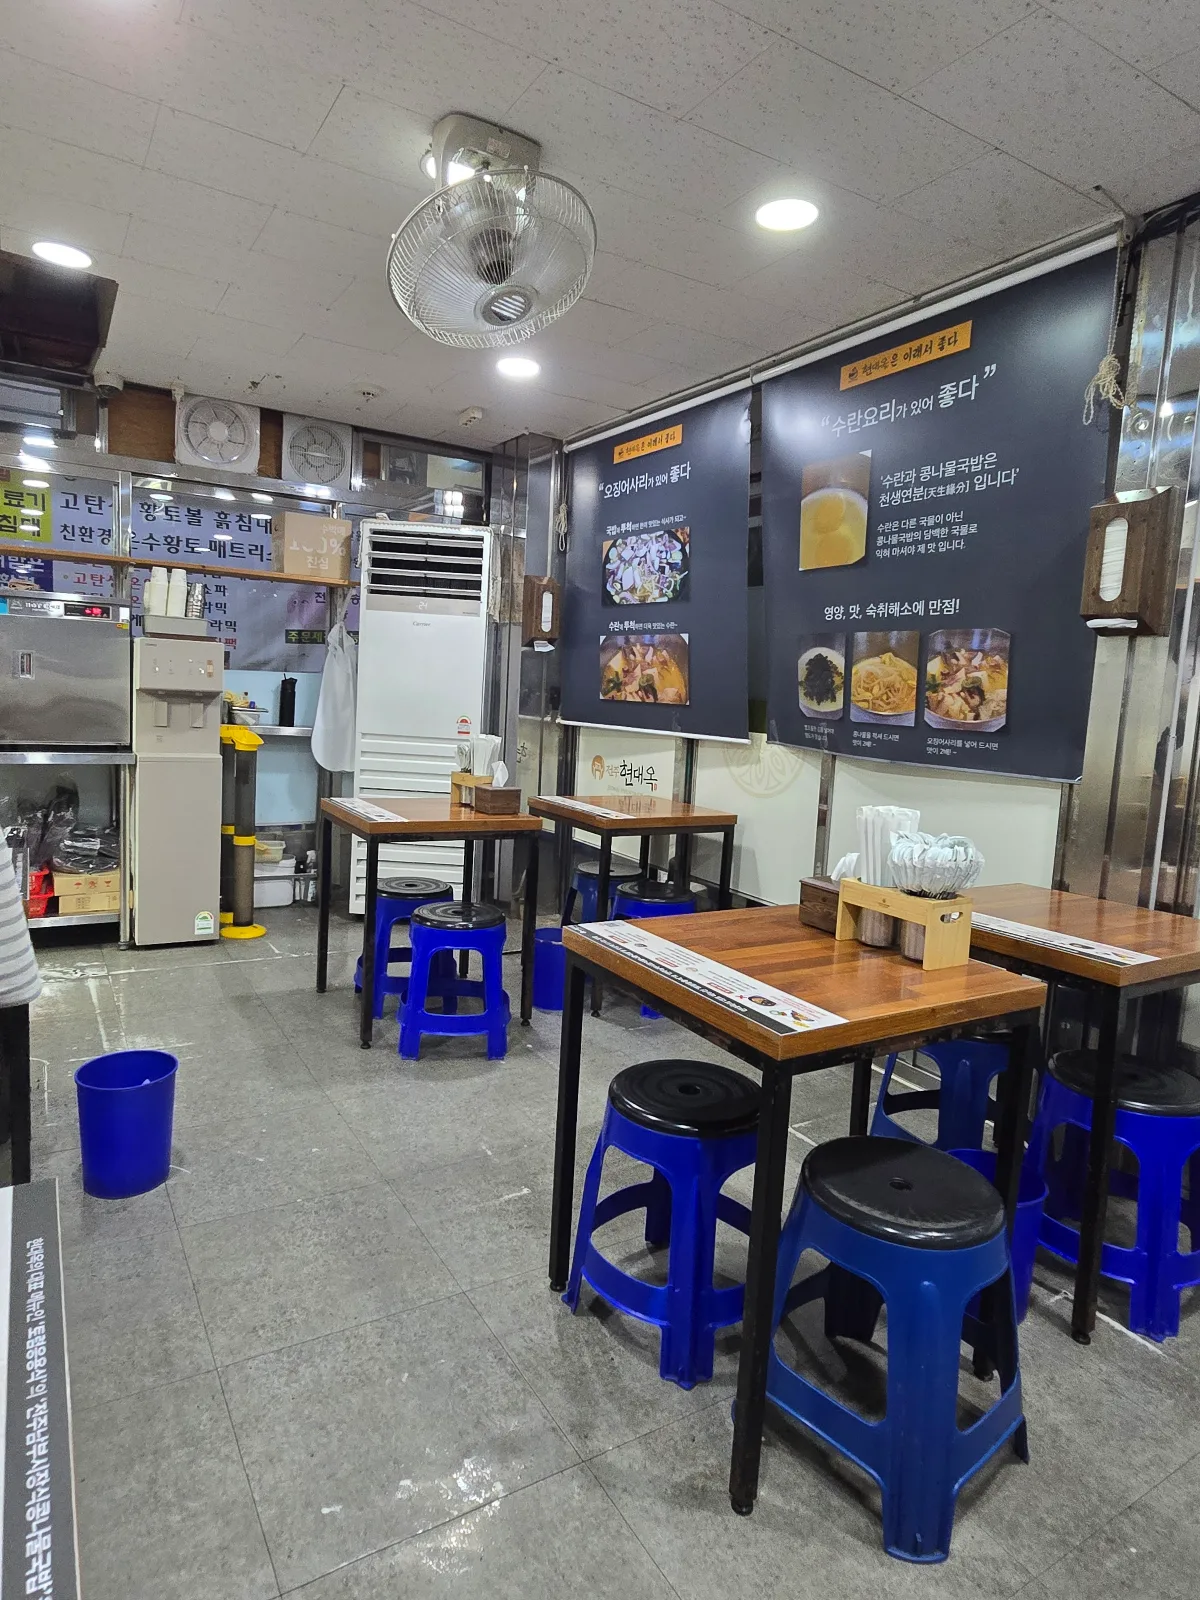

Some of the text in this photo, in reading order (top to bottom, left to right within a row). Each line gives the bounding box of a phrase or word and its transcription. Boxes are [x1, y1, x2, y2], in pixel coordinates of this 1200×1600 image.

[862, 332, 959, 377] 현대옥은 이래서 좋다
[910, 395, 934, 417] 있어
[655, 472, 668, 486] 있어
[669, 461, 691, 483] 좋다
[919, 452, 998, 483] 콩나물국밥은
[60, 491, 113, 516] 고탄
[139, 501, 272, 535] 황토볼 흙침대
[877, 510, 963, 533] 수란은 다른 국물이 아닌
[60, 523, 112, 546] 친환경
[876, 523, 978, 546] 콩나물국밥의 담백한 국물로
[875, 547, 890, 560] 익혀
[891, 544, 915, 558] 마셔야
[917, 542, 926, 555] 제
[927, 541, 936, 554] 맛
[824, 598, 960, 621] 영양, 맛, 숙취해소에 만점!
[412, 620, 432, 628] Carrier
[978, 741, 999, 752] 드시면
[619, 760, 658, 792] 현대옥
[25, 1237, 46, 1273] 현대옥의
[25, 1272, 46, 1293] 대표
[25, 1291, 46, 1323] 메뉴인
